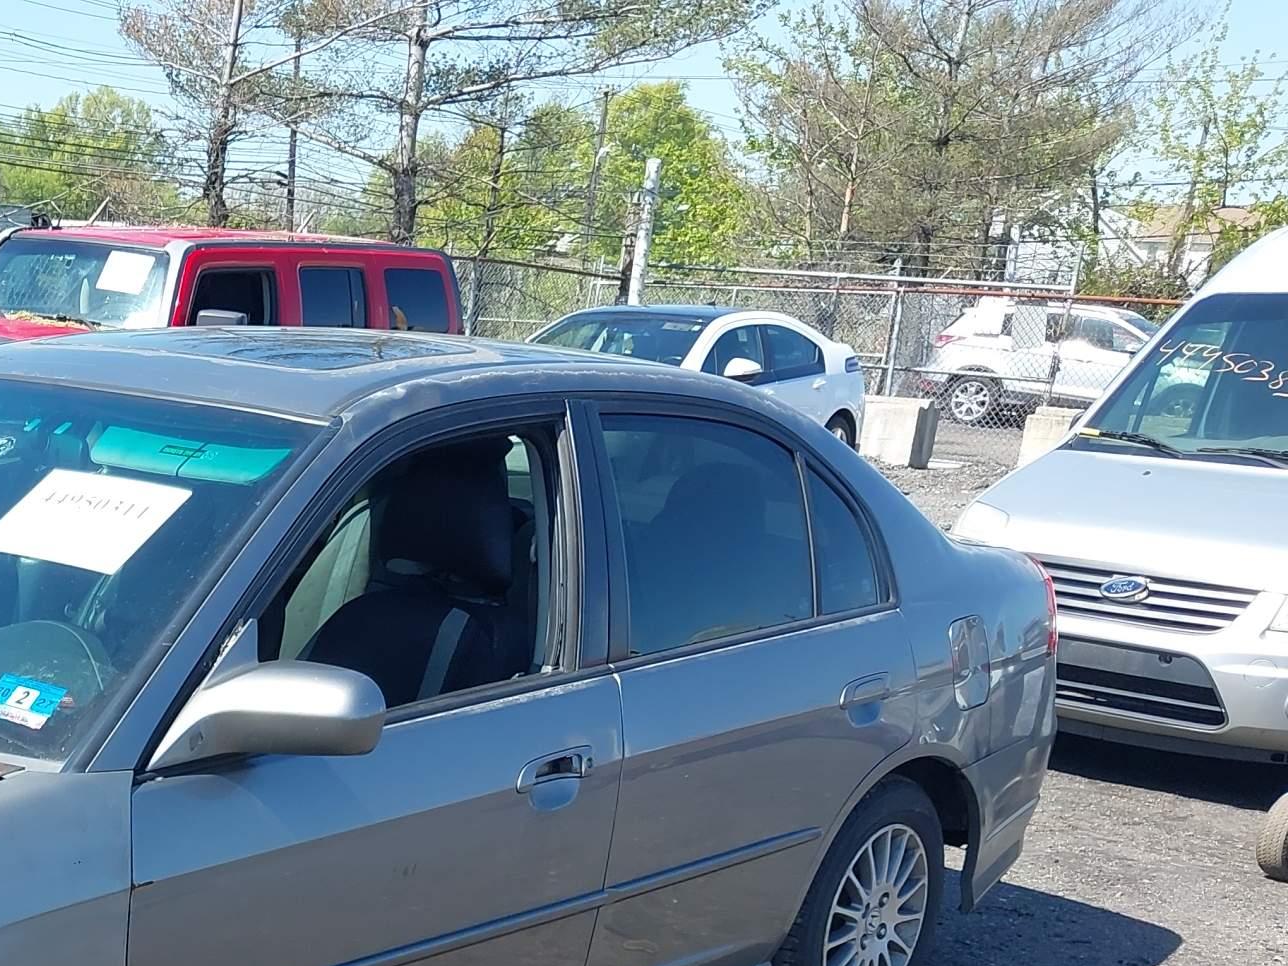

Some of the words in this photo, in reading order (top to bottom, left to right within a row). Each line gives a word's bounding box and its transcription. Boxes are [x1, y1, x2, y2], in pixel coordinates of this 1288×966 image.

[1155, 338, 1288, 397] 4495038
[1110, 581, 1136, 593] Ford
[15, 691, 30, 704] 2
